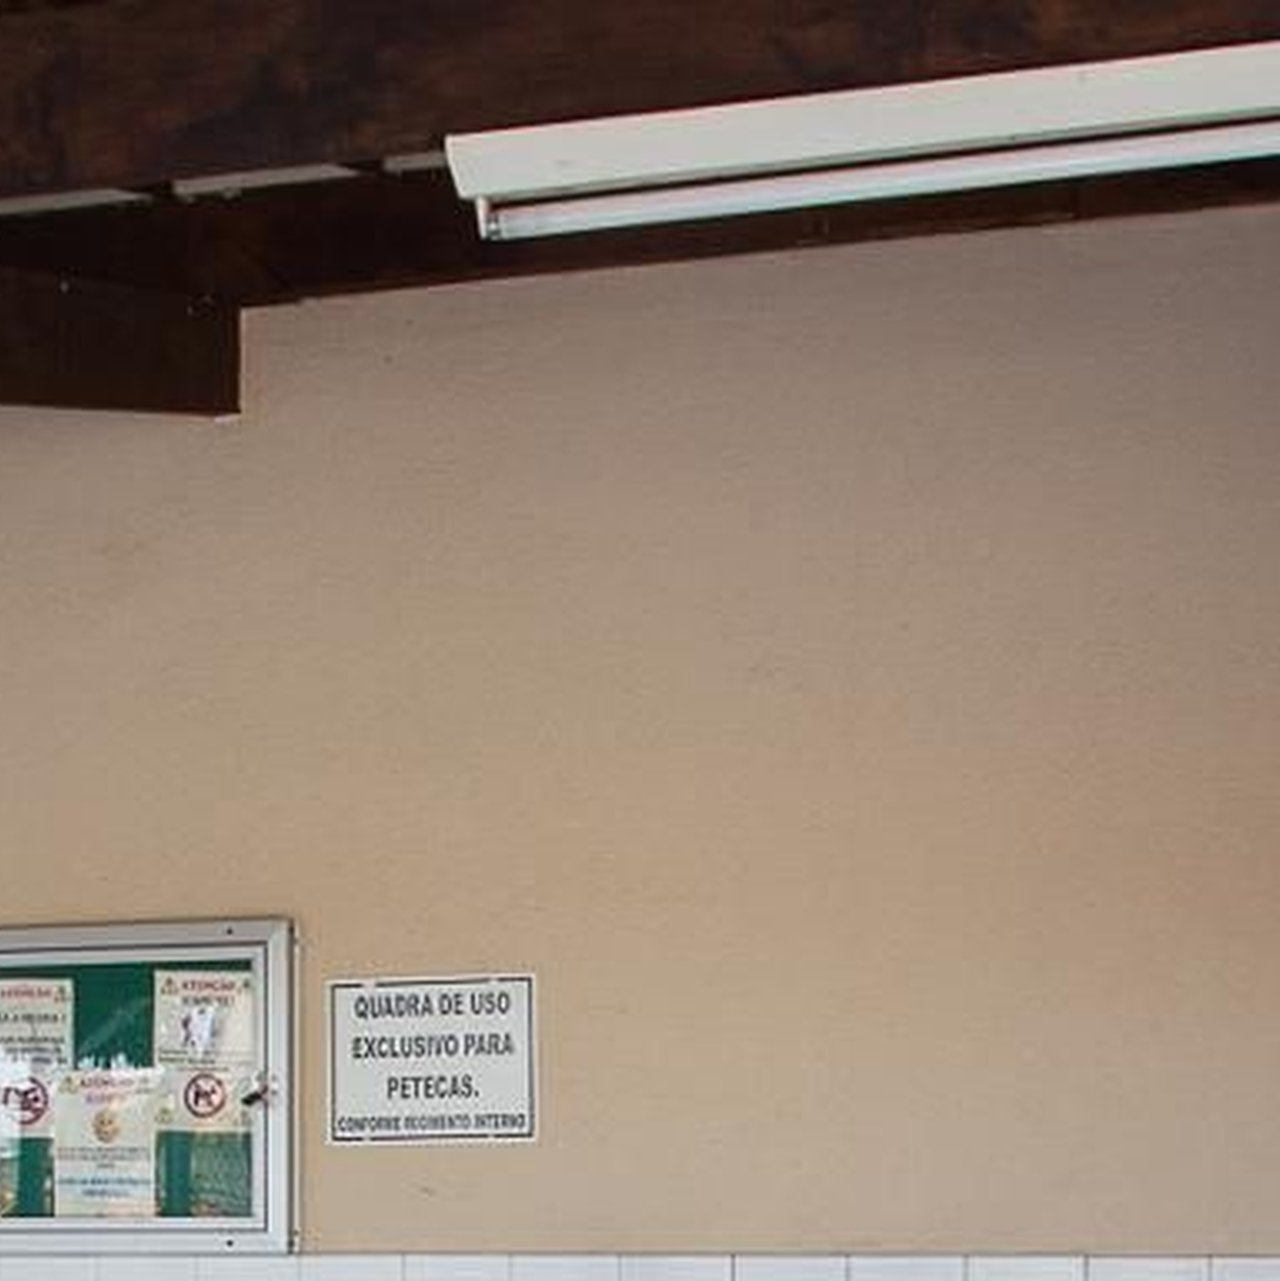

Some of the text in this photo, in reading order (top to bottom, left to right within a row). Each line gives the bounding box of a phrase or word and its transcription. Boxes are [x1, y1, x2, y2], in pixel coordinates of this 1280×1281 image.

[353, 991, 511, 1019] QUADRA DE USO
[352, 1033, 515, 1059] EXCLUSIVO PARA
[386, 1075, 480, 1100] PETECAS.
[338, 1116, 402, 1133] CONFORME
[475, 1113, 526, 1129] INTERNO
